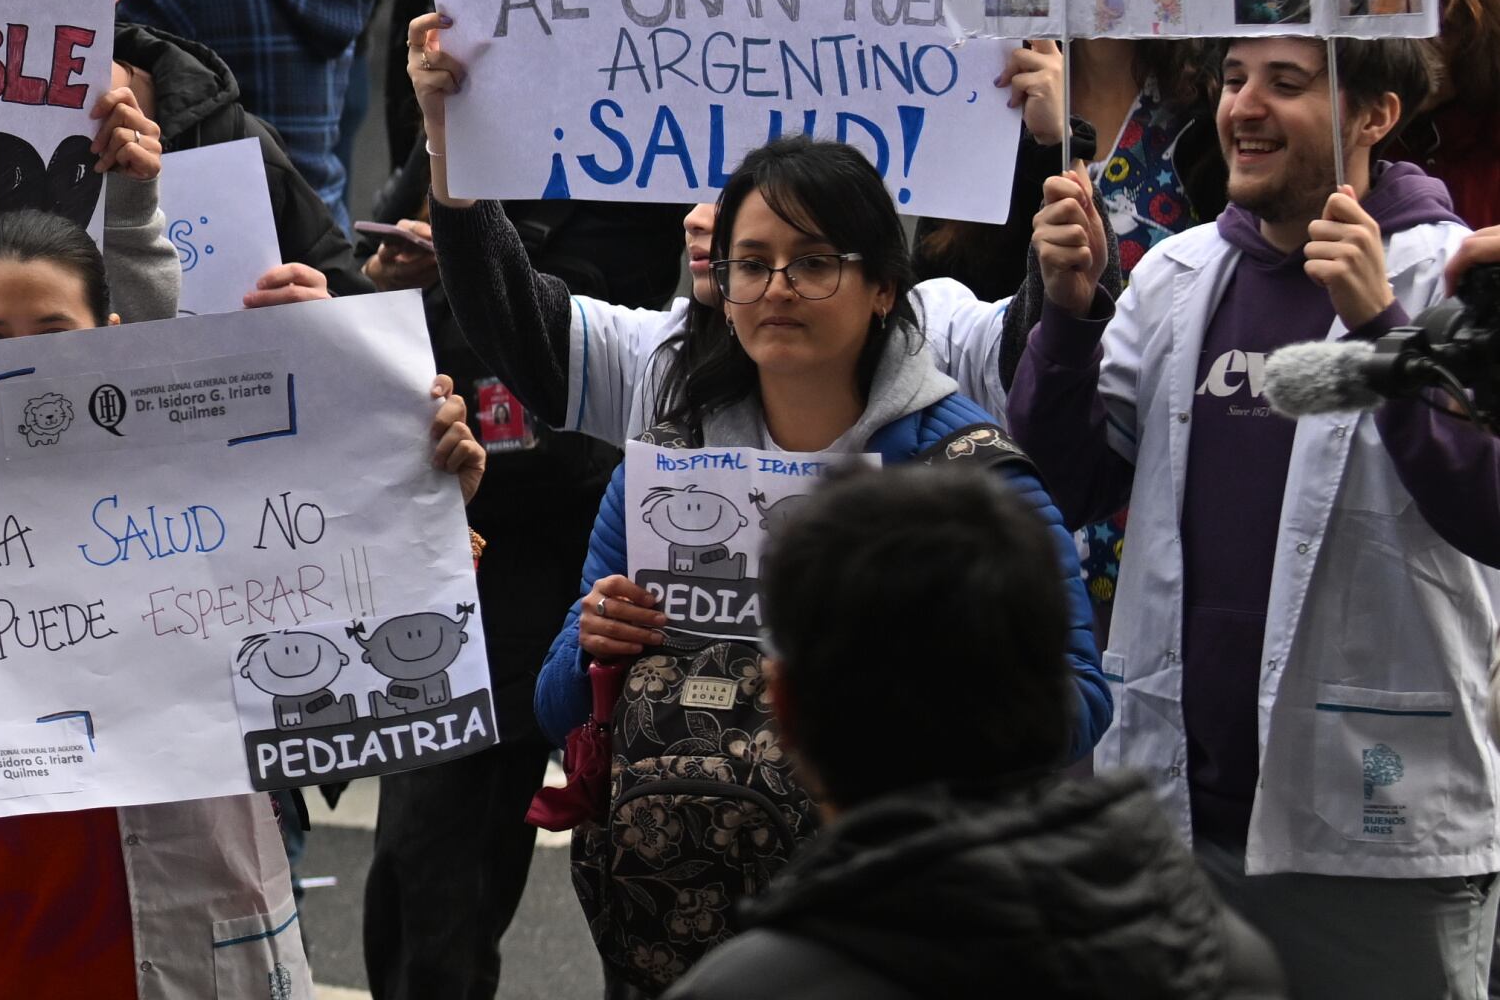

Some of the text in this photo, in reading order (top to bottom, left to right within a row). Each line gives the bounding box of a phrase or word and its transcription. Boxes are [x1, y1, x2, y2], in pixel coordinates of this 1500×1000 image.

[130, 371, 274, 397] HOSPITAL ZONAL GENERAL DE AGUDOS
[135, 383, 271, 412] Dr. Isidoro G. Iriarte
[169, 405, 226, 423] Quilmes
[78, 494, 226, 567] SALUD
[253, 491, 326, 551] NO
[693, 684, 727, 693] BILLA
[692, 693, 724, 702] BONG
[256, 706, 487, 780] PEDIATRIA
[35, 755, 47, 765] G.
[49, 754, 84, 764] Iriarte
[3, 768, 50, 780] Quilmes
[1364, 816, 1406, 824] BUENOS
[1364, 825, 1393, 834] AIRES
